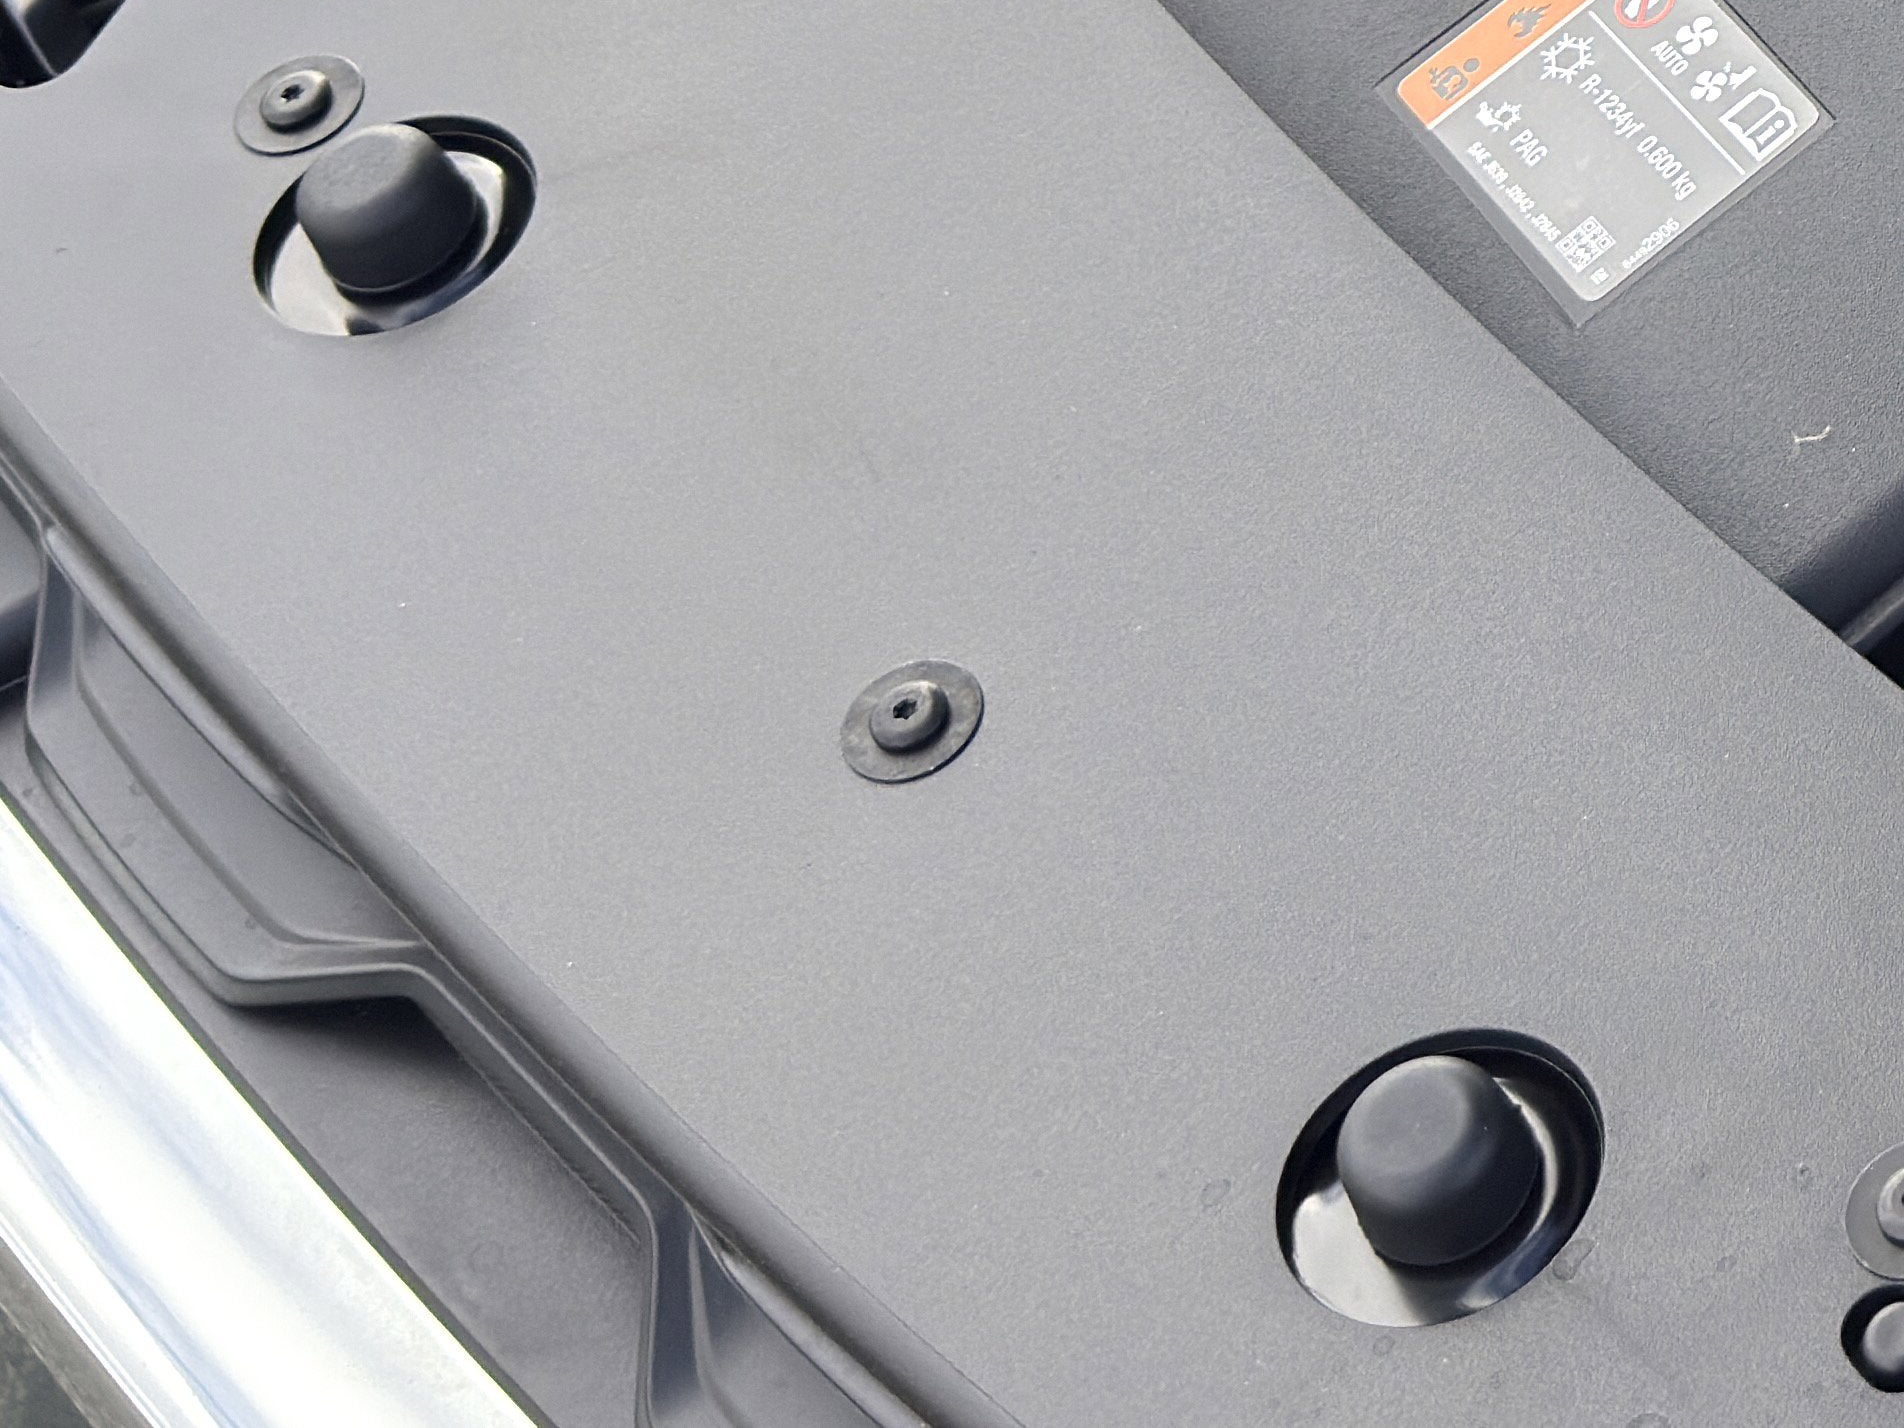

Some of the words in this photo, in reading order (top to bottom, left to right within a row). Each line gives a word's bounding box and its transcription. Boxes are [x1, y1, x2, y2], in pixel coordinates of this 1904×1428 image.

[1650, 40, 1689, 76] AUTO
[1509, 128, 1548, 167] PAG
[1579, 73, 1646, 139] R-1234yf
[1637, 135, 1683, 179] 0.600
[1671, 170, 1697, 201] kg
